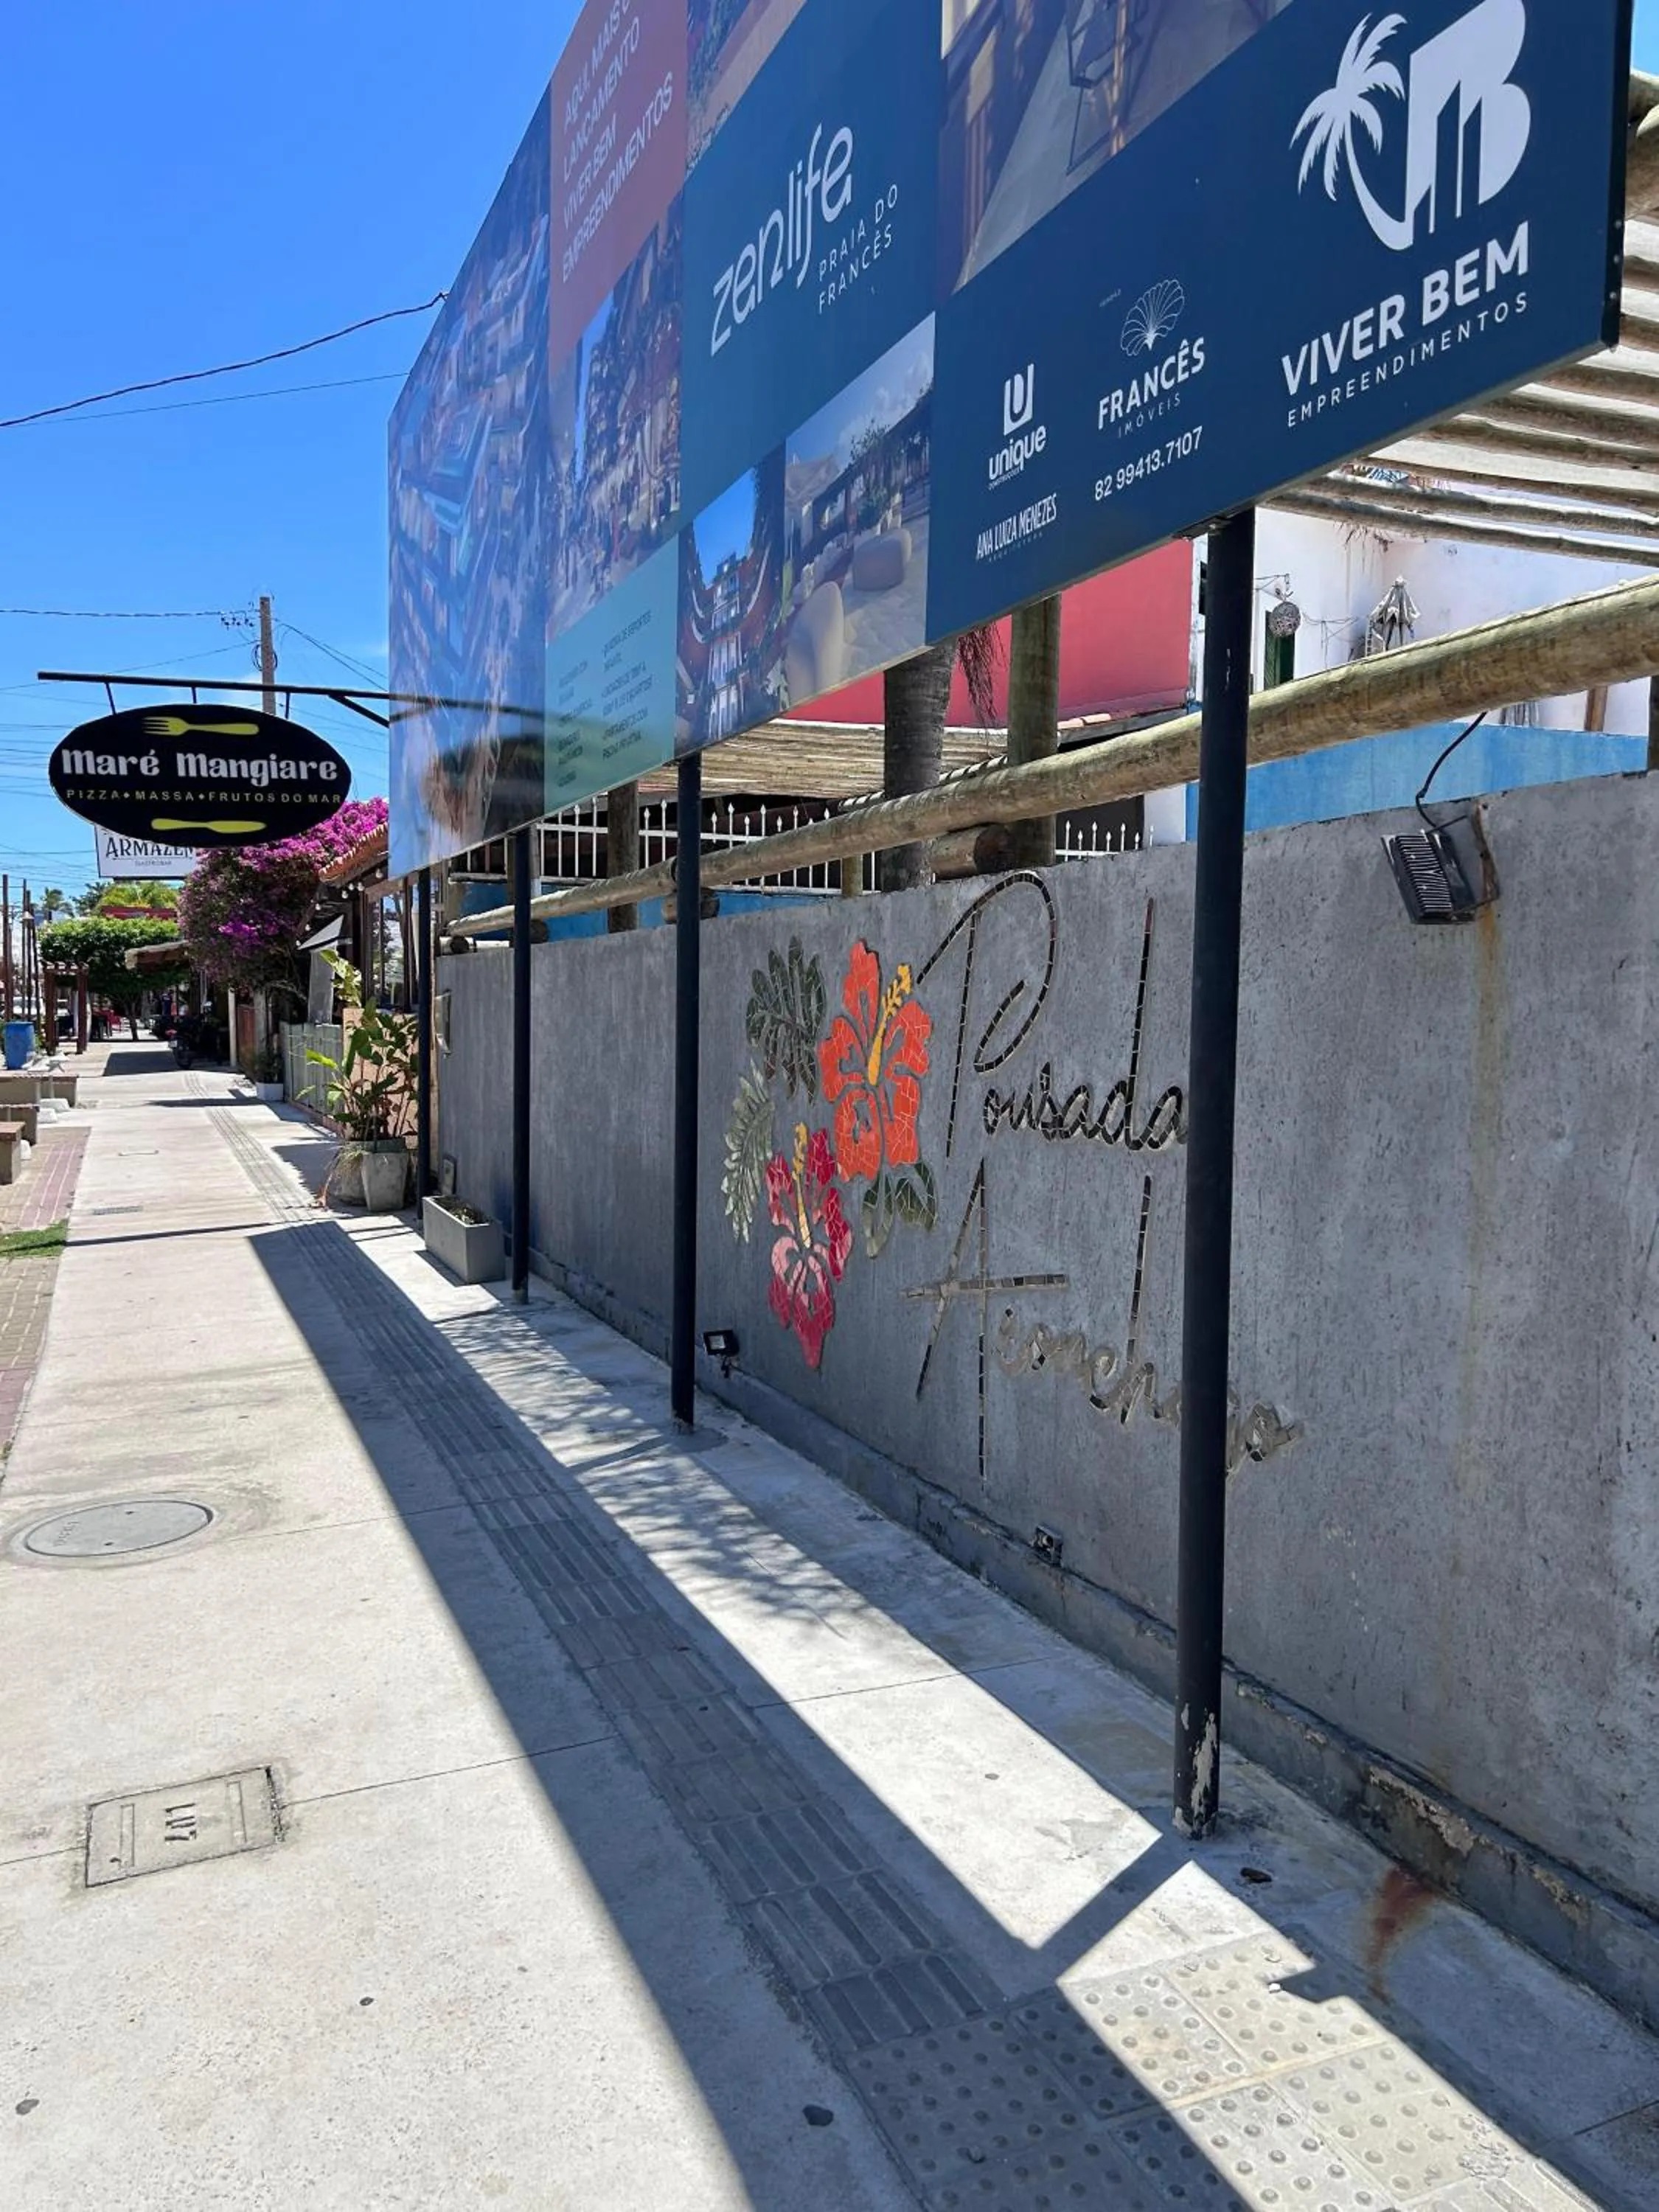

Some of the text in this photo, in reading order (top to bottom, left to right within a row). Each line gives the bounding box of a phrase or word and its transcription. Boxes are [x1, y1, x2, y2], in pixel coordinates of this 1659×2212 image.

[592, 0, 620, 77] MAIS
[562, 72, 674, 283] EMPREENDIMENTOS
[563, 113, 616, 229] VIVER BEM
[711, 122, 853, 357] zenlife
[818, 184, 898, 282] PRAIA DO
[818, 224, 892, 315] FRANCÊS
[1281, 221, 1528, 396] VIVER BEM
[1098, 337, 1206, 430] FRANCÊS
[1287, 292, 1528, 428] EMPREENDIMENTOS
[989, 425, 1047, 481] unique
[1119, 392, 1180, 438] IMÓVEIS
[1095, 425, 1203, 501] 82 99413.7107
[976, 528, 993, 561] ANA
[994, 515, 1017, 551] LUIZA
[1019, 492, 1057, 538] MENEZES
[61, 749, 338, 787] Maré Mangiare
[209, 792, 276, 803] FRUTOS
[281, 793, 303, 804] DO
[308, 794, 342, 804] MAR
[917, 870, 1189, 1158] Pousada
